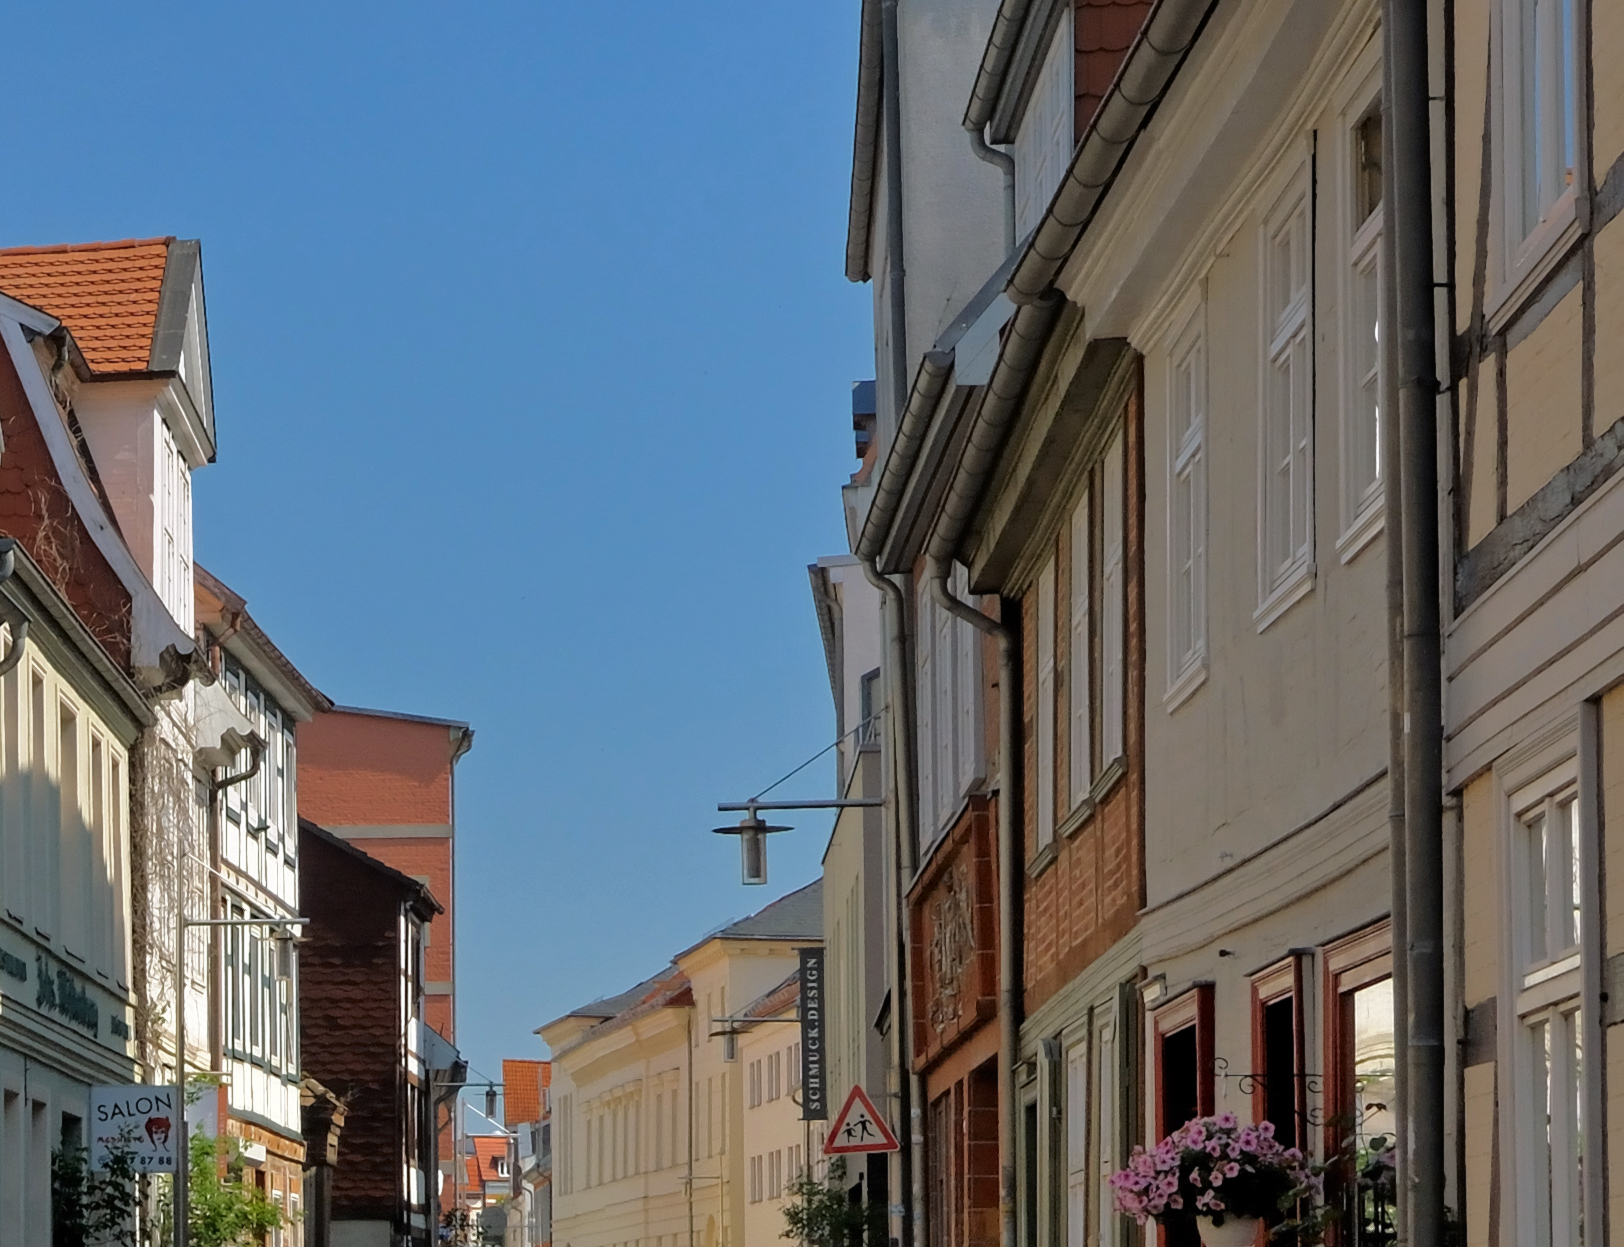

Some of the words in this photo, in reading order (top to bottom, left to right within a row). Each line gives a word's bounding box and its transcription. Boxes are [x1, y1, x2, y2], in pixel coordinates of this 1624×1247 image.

[806, 957, 821, 1110] SCHMUCK.DESIGN
[97, 1092, 173, 1122] SALON
[140, 1156, 154, 1165] 87
[158, 1156, 172, 1165] 88
